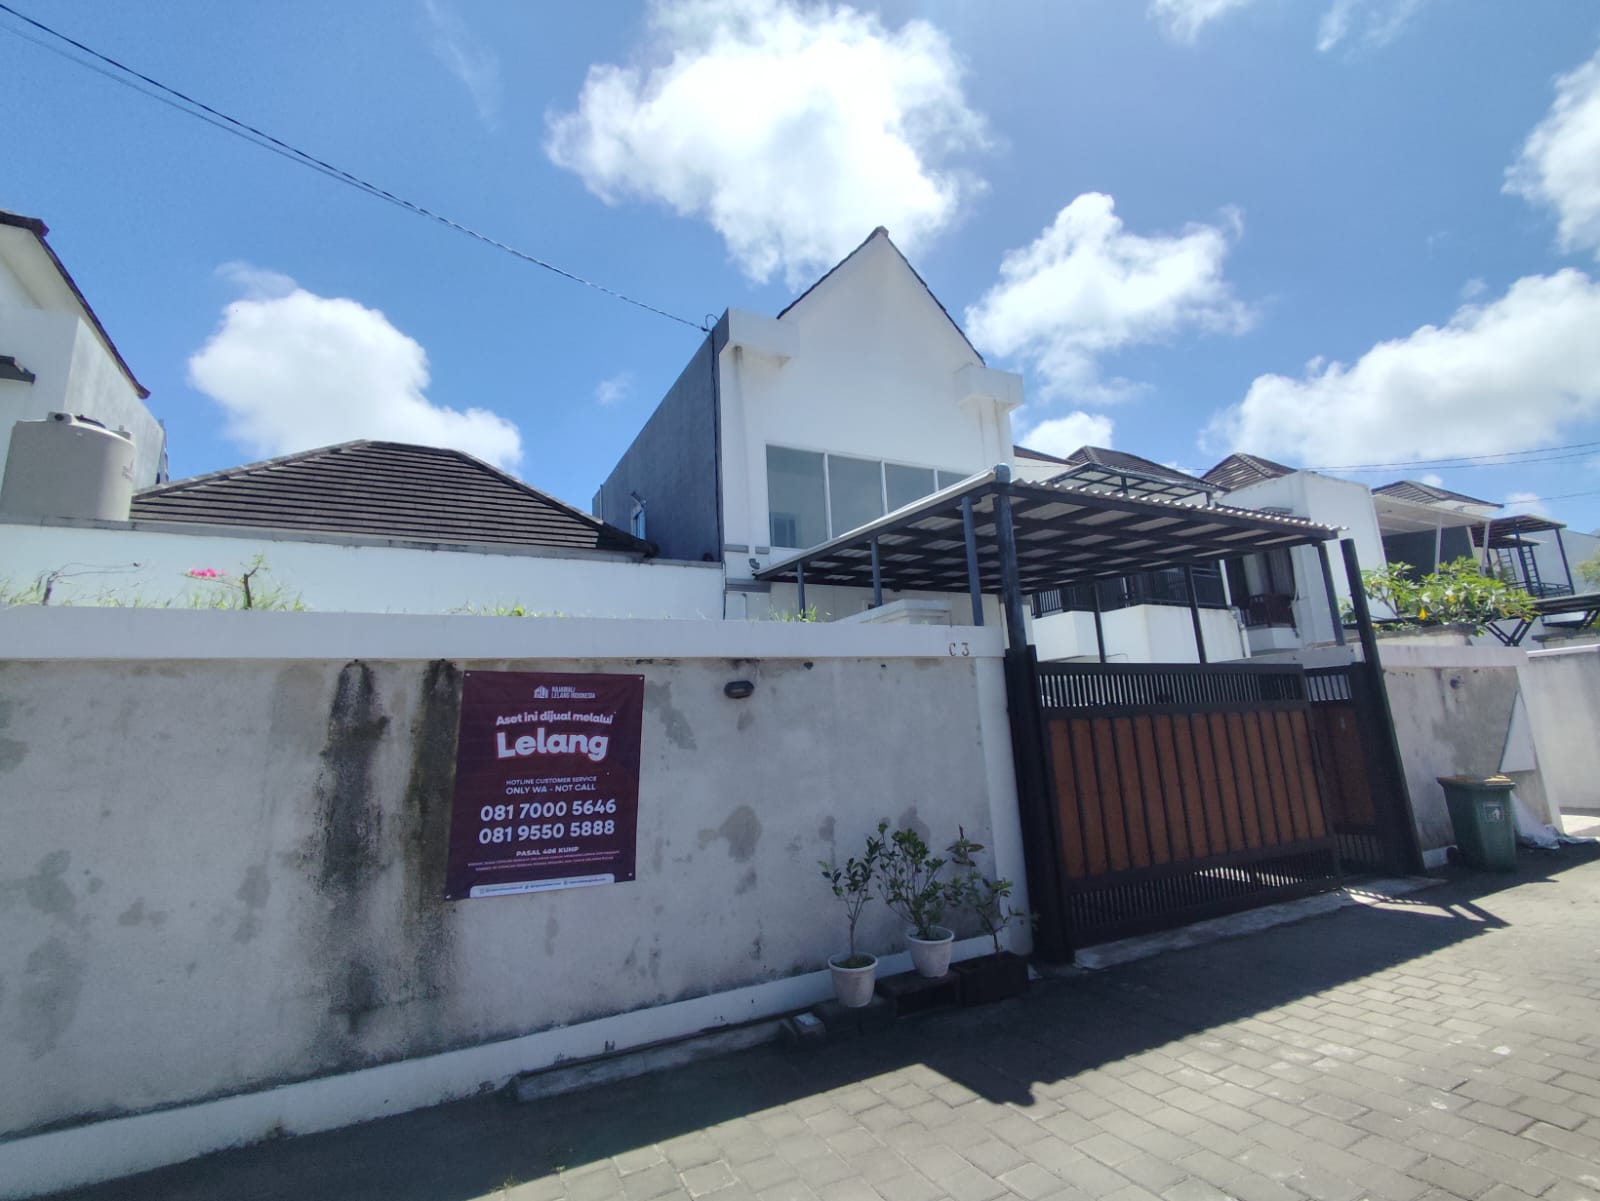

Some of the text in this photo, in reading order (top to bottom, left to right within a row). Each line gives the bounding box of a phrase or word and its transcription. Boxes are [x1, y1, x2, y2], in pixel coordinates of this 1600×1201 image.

[496, 710, 614, 726] Aset ini dijual melalui
[496, 727, 609, 761] Lelang
[506, 778, 534, 786] HOTLINE
[506, 786, 530, 795] ONLY
[532, 786, 547, 794] WA
[555, 784, 573, 793] NOT
[575, 783, 596, 791] CALL
[480, 799, 616, 821] 081 7000 5646
[479, 820, 615, 844] 081 9550 5888
[516, 849, 541, 857] PASAL
